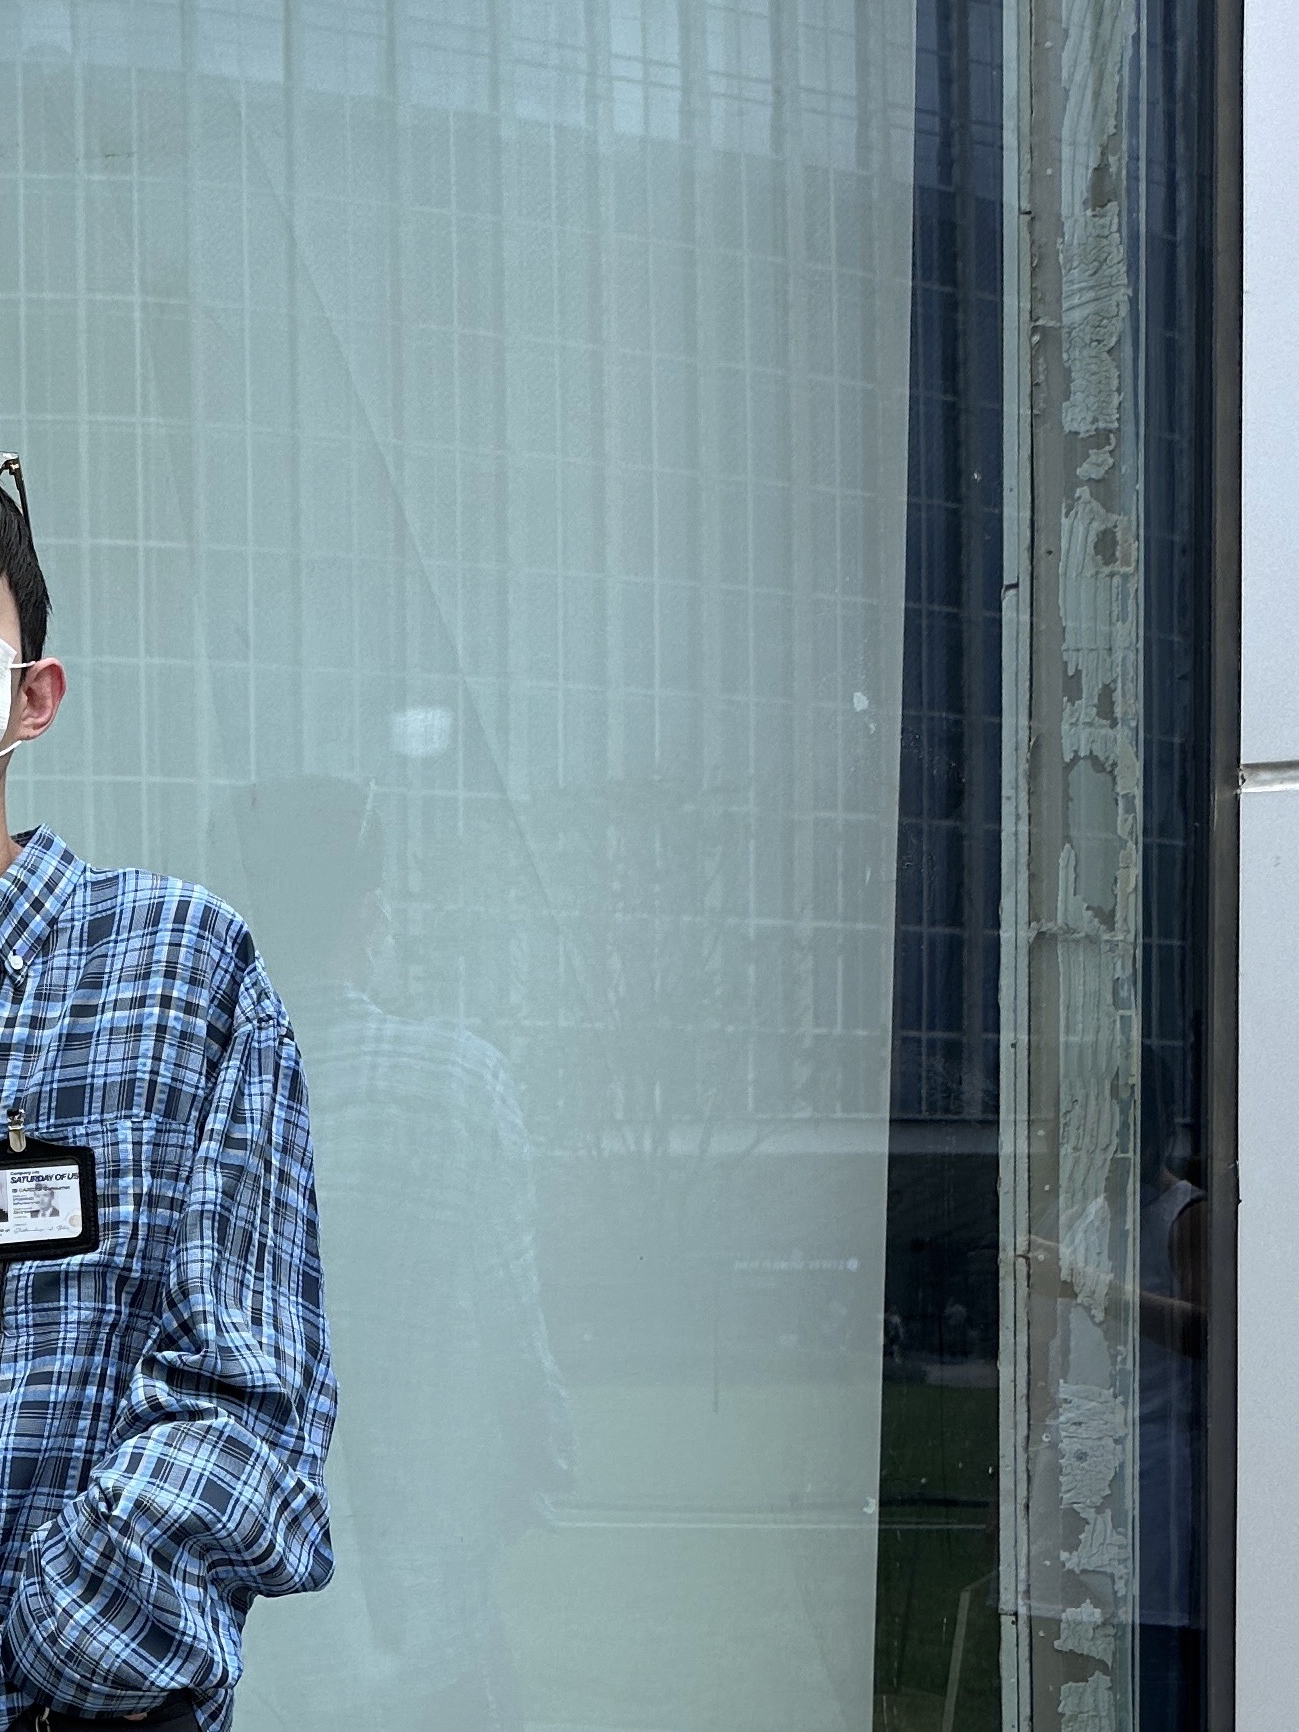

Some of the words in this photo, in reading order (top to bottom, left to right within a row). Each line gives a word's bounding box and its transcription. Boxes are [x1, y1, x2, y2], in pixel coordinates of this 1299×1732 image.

[10, 1174, 54, 1184] SATURDAY
[55, 1173, 67, 1181] OF
[67, 1172, 80, 1181] US
